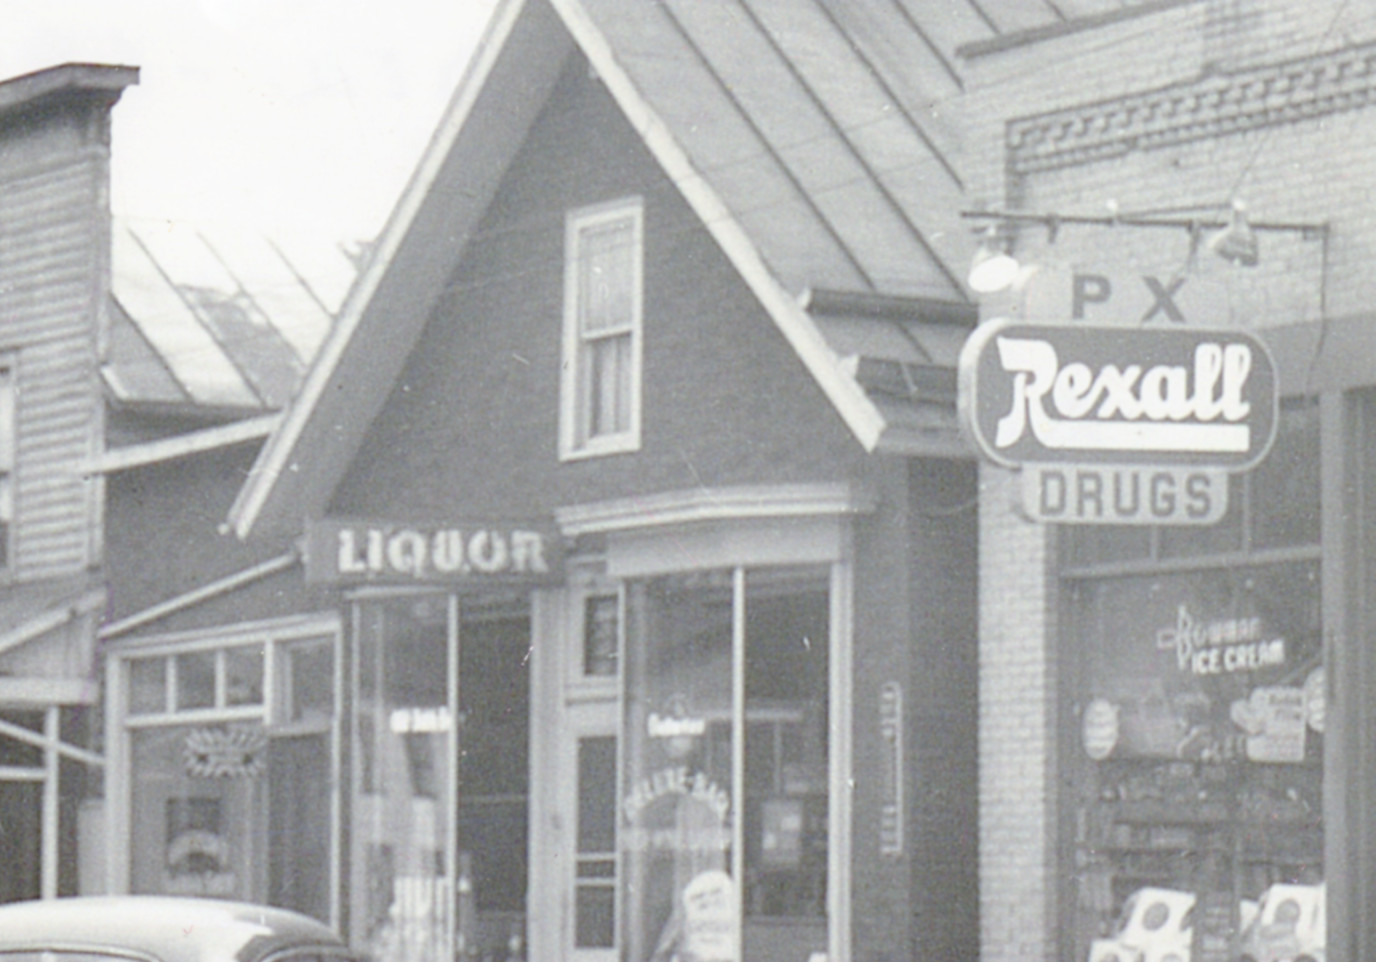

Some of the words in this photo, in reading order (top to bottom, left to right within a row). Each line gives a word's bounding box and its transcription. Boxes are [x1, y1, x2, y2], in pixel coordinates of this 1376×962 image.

[996, 336, 1251, 450] Rexall
[1039, 470, 1211, 518] DRUGS
[338, 529, 550, 577] LIQUOR
[1192, 647, 1221, 674] ICE
[1225, 638, 1285, 672] CREAM
